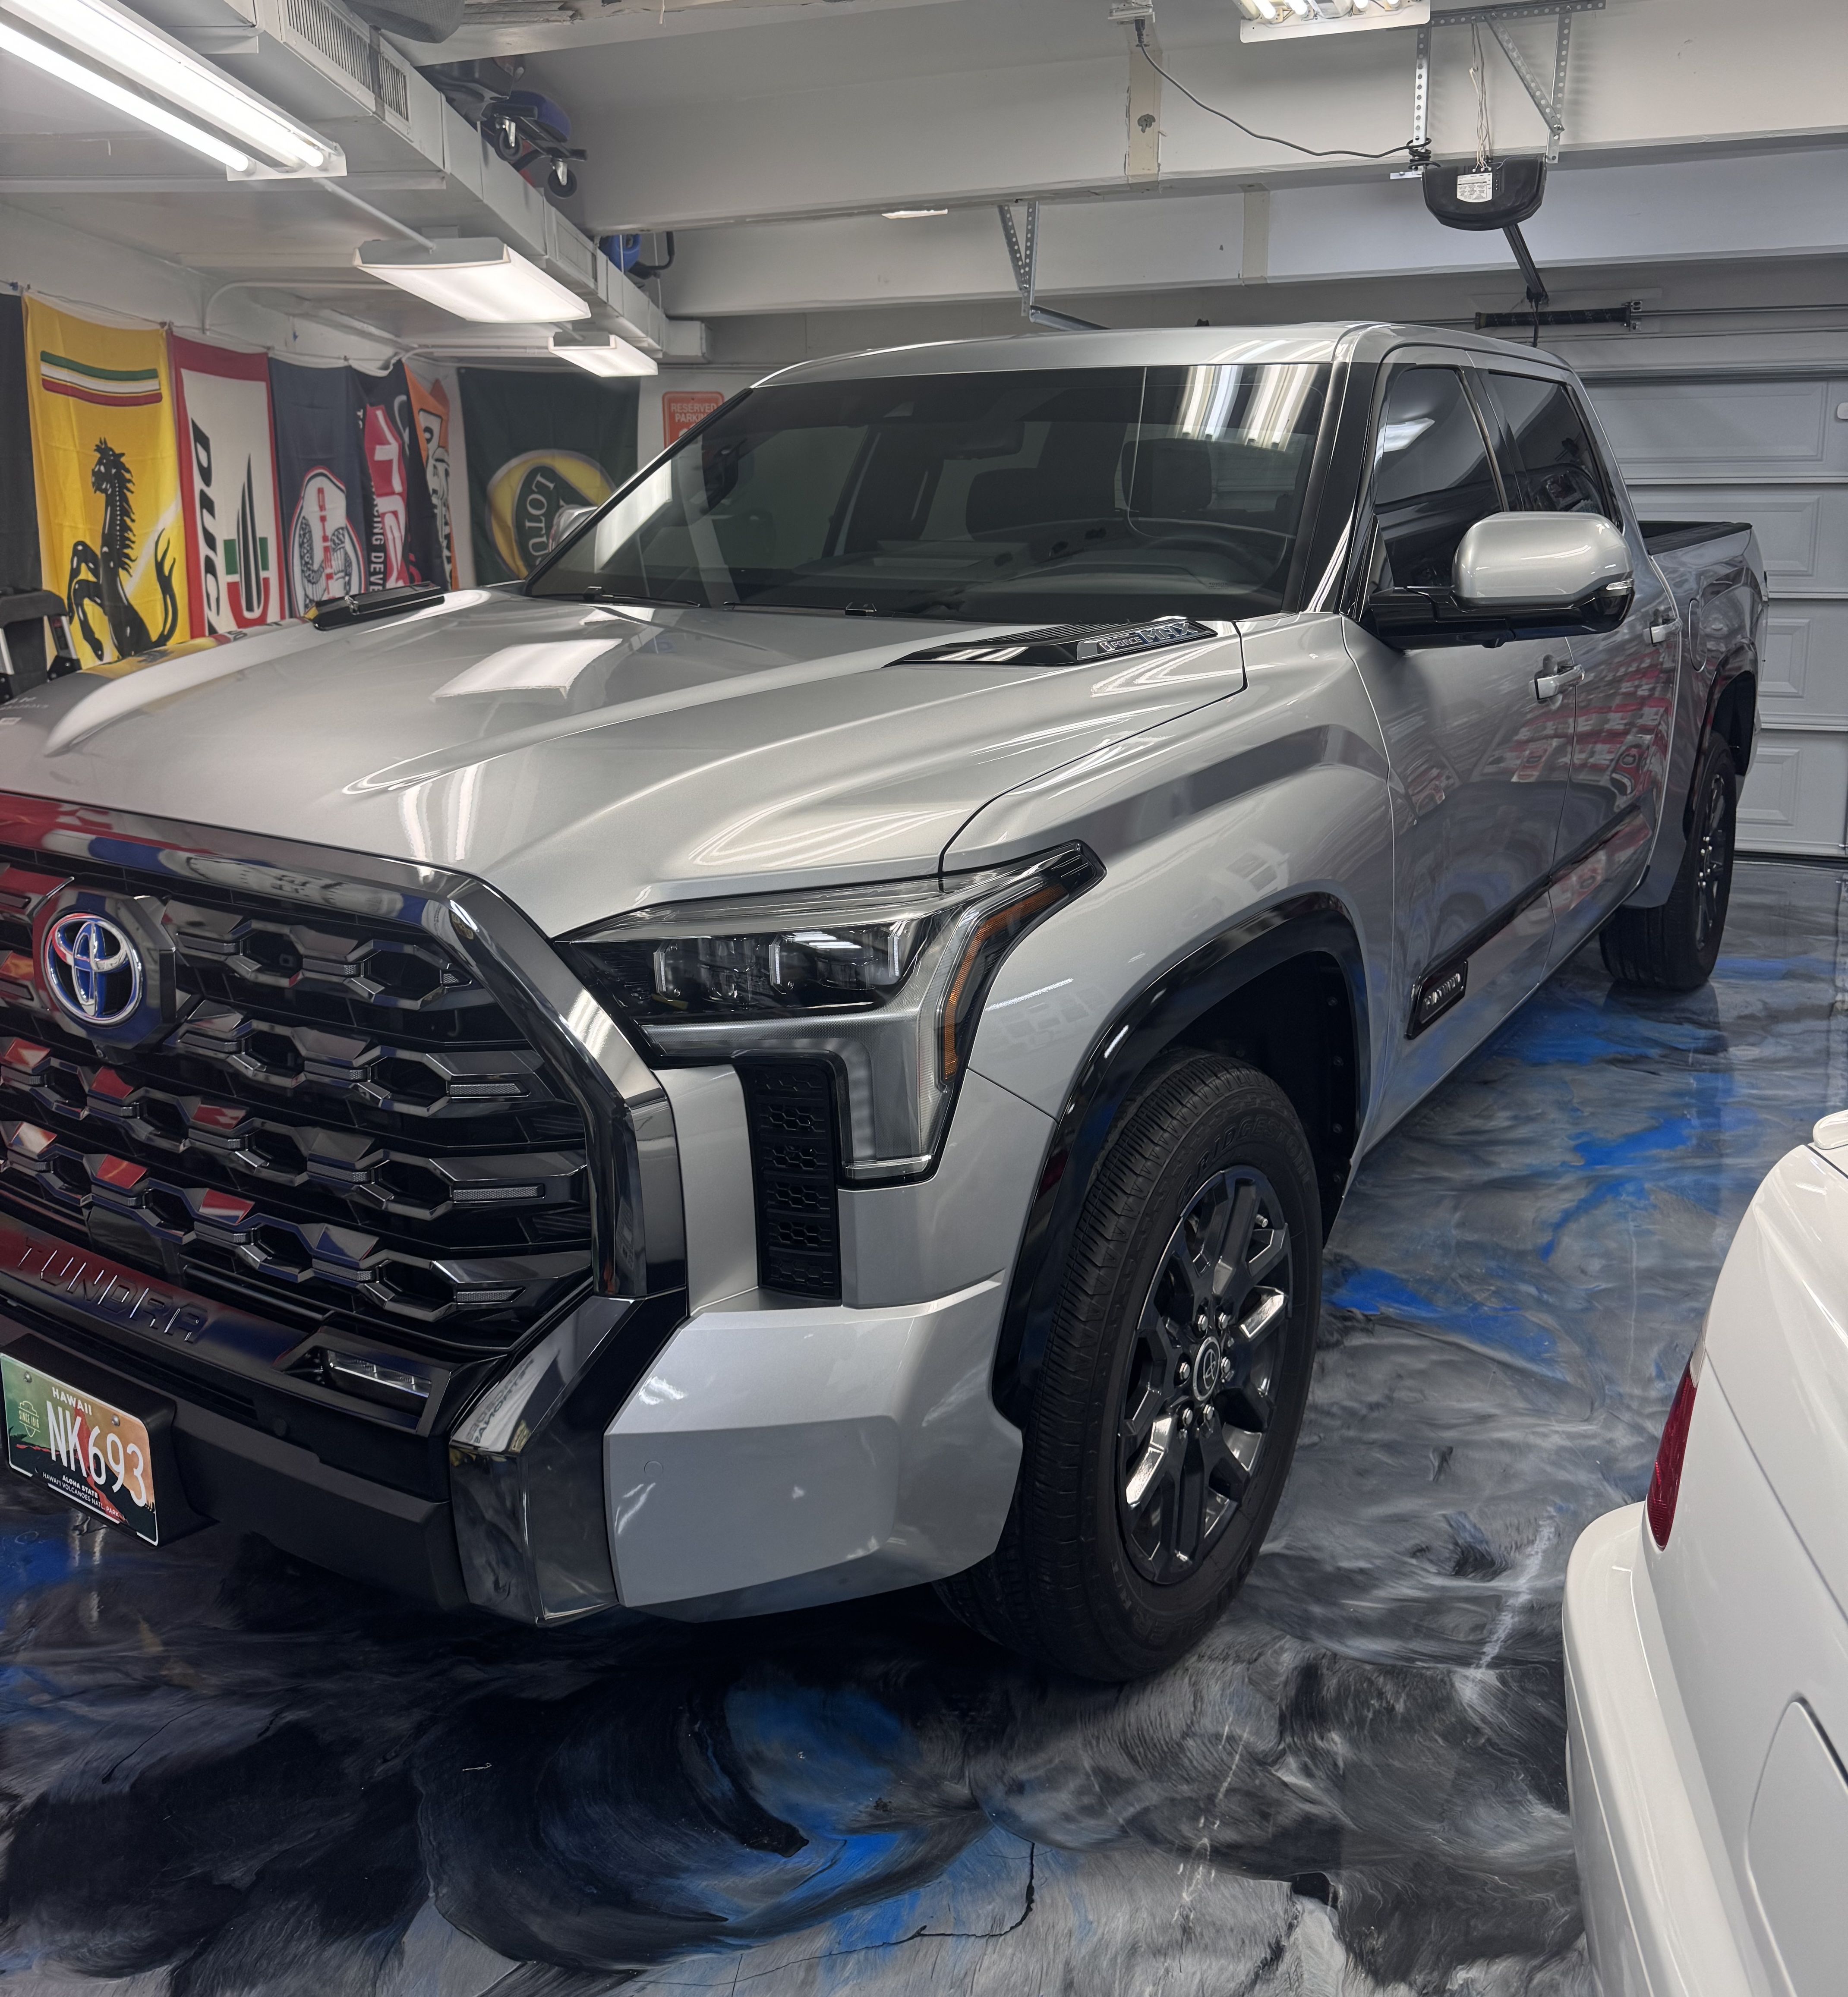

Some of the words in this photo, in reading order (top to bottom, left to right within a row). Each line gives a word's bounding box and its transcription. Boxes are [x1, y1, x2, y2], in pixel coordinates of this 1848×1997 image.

[670, 403, 717, 413] RESERVED
[525, 472, 556, 566] LOTU
[1139, 621, 1198, 643] MAX
[17, 1236, 209, 1343] TUNDRA
[52, 1386, 92, 1416] HAWAII
[46, 1400, 146, 1507] NK693
[61, 1481, 91, 1502] VOLCANOES
[106, 1506, 120, 1518] PARK
[62, 1474, 81, 1489] ALOHA
[81, 1485, 98, 1499] STATE
